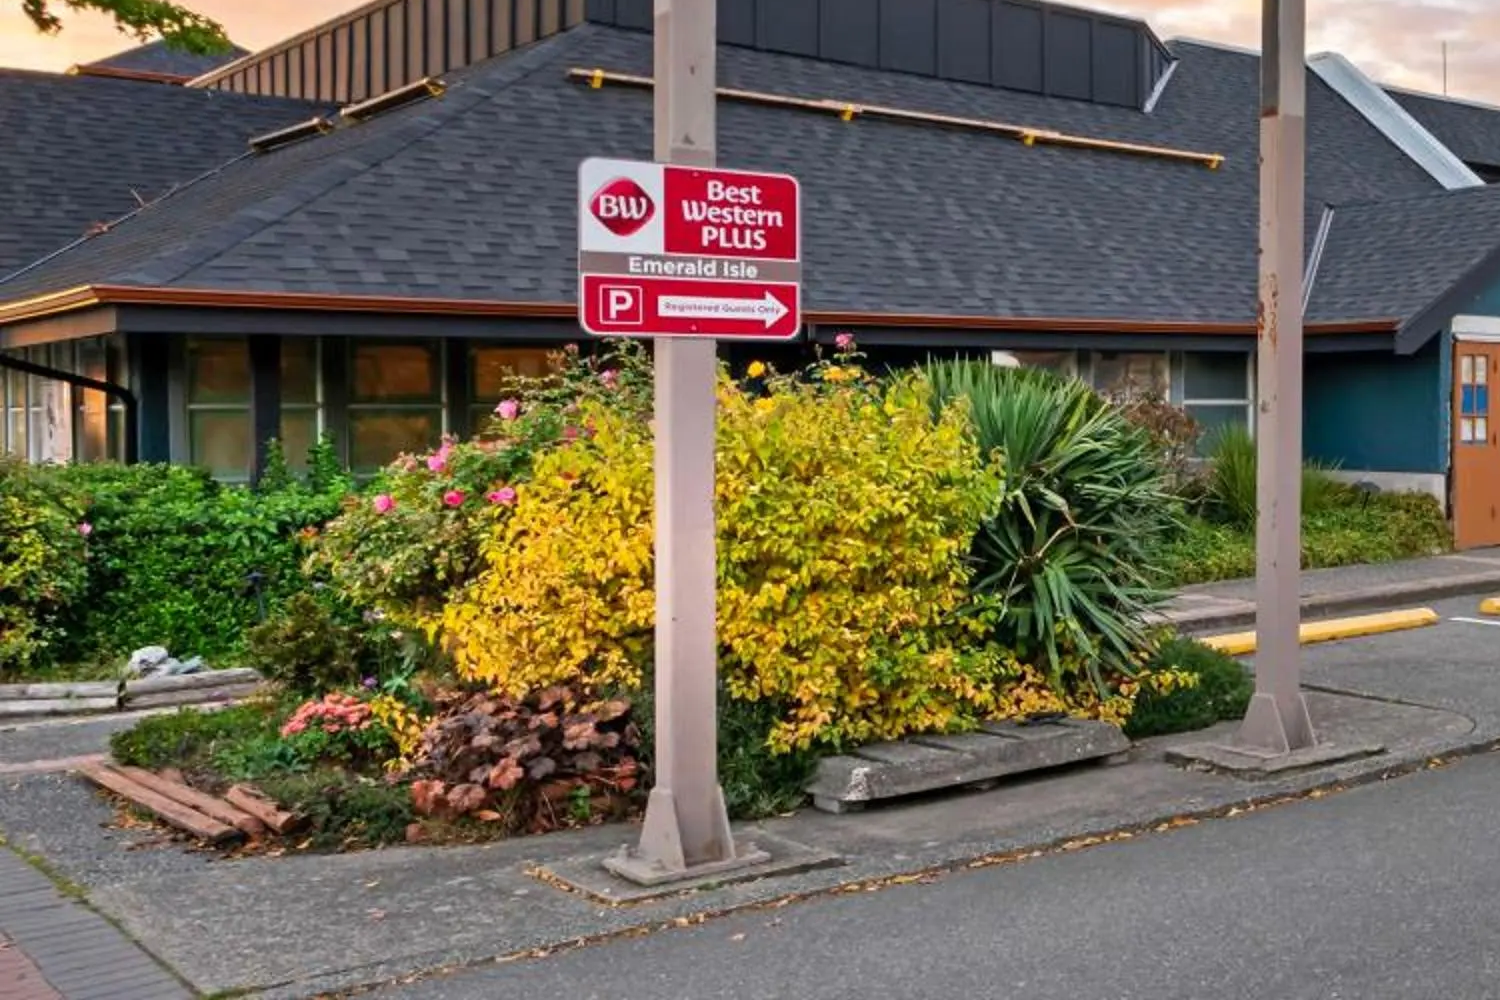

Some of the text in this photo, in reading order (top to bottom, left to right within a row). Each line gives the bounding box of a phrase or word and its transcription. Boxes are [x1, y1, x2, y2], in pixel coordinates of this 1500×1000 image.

[706, 180, 762, 205] Best
[598, 194, 648, 219] BW
[681, 199, 784, 227] Western
[701, 226, 767, 250] PLUS
[628, 256, 759, 279] Emerald Isle
[609, 289, 633, 319] P
